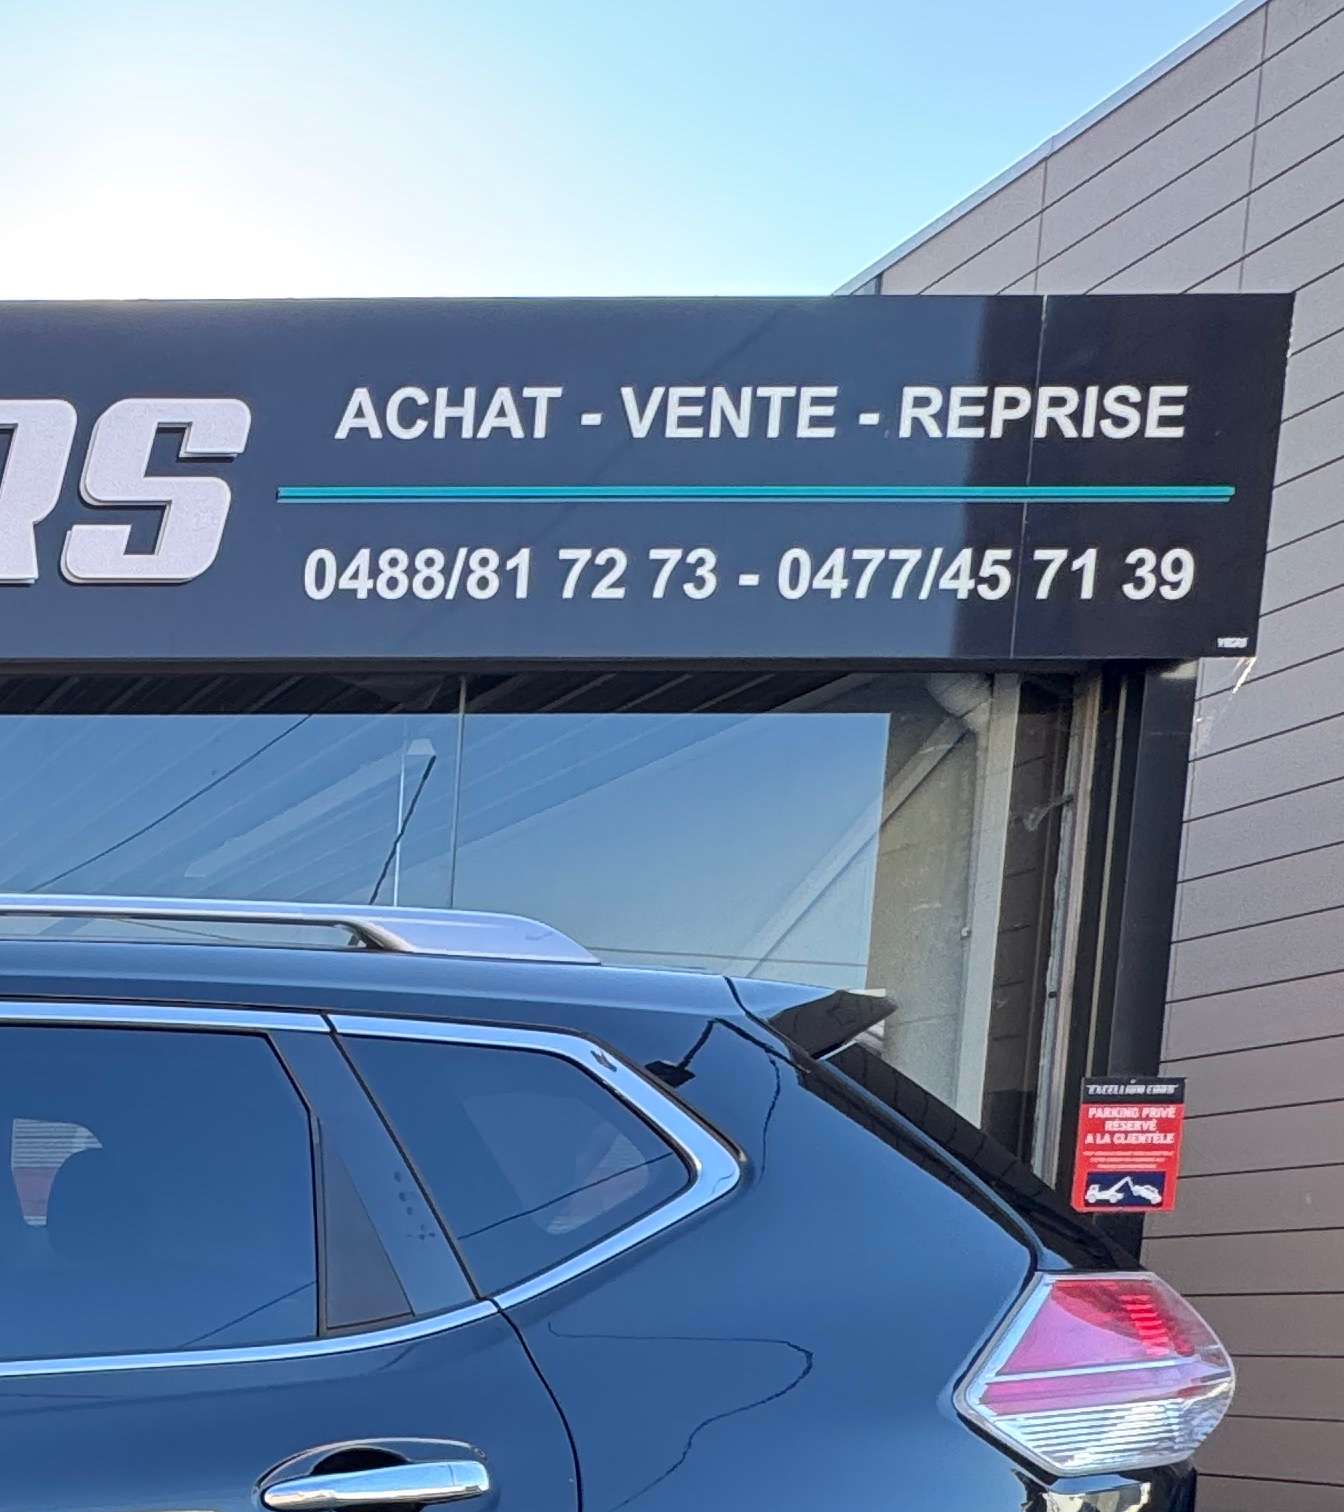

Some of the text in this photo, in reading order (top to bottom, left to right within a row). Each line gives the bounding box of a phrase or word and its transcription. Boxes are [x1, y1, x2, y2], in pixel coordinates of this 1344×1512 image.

[333, 385, 563, 441] ACHAT
[619, 384, 839, 439] VENTE
[898, 384, 1190, 439] REPRISE
[303, 547, 531, 600] 0488/81
[558, 547, 628, 600] 72
[648, 547, 719, 600] 73
[777, 547, 1014, 601] 0477/45
[1031, 547, 1100, 600] 71
[1121, 547, 1196, 600] 39
[1088, 1106, 1139, 1119] PARKING
